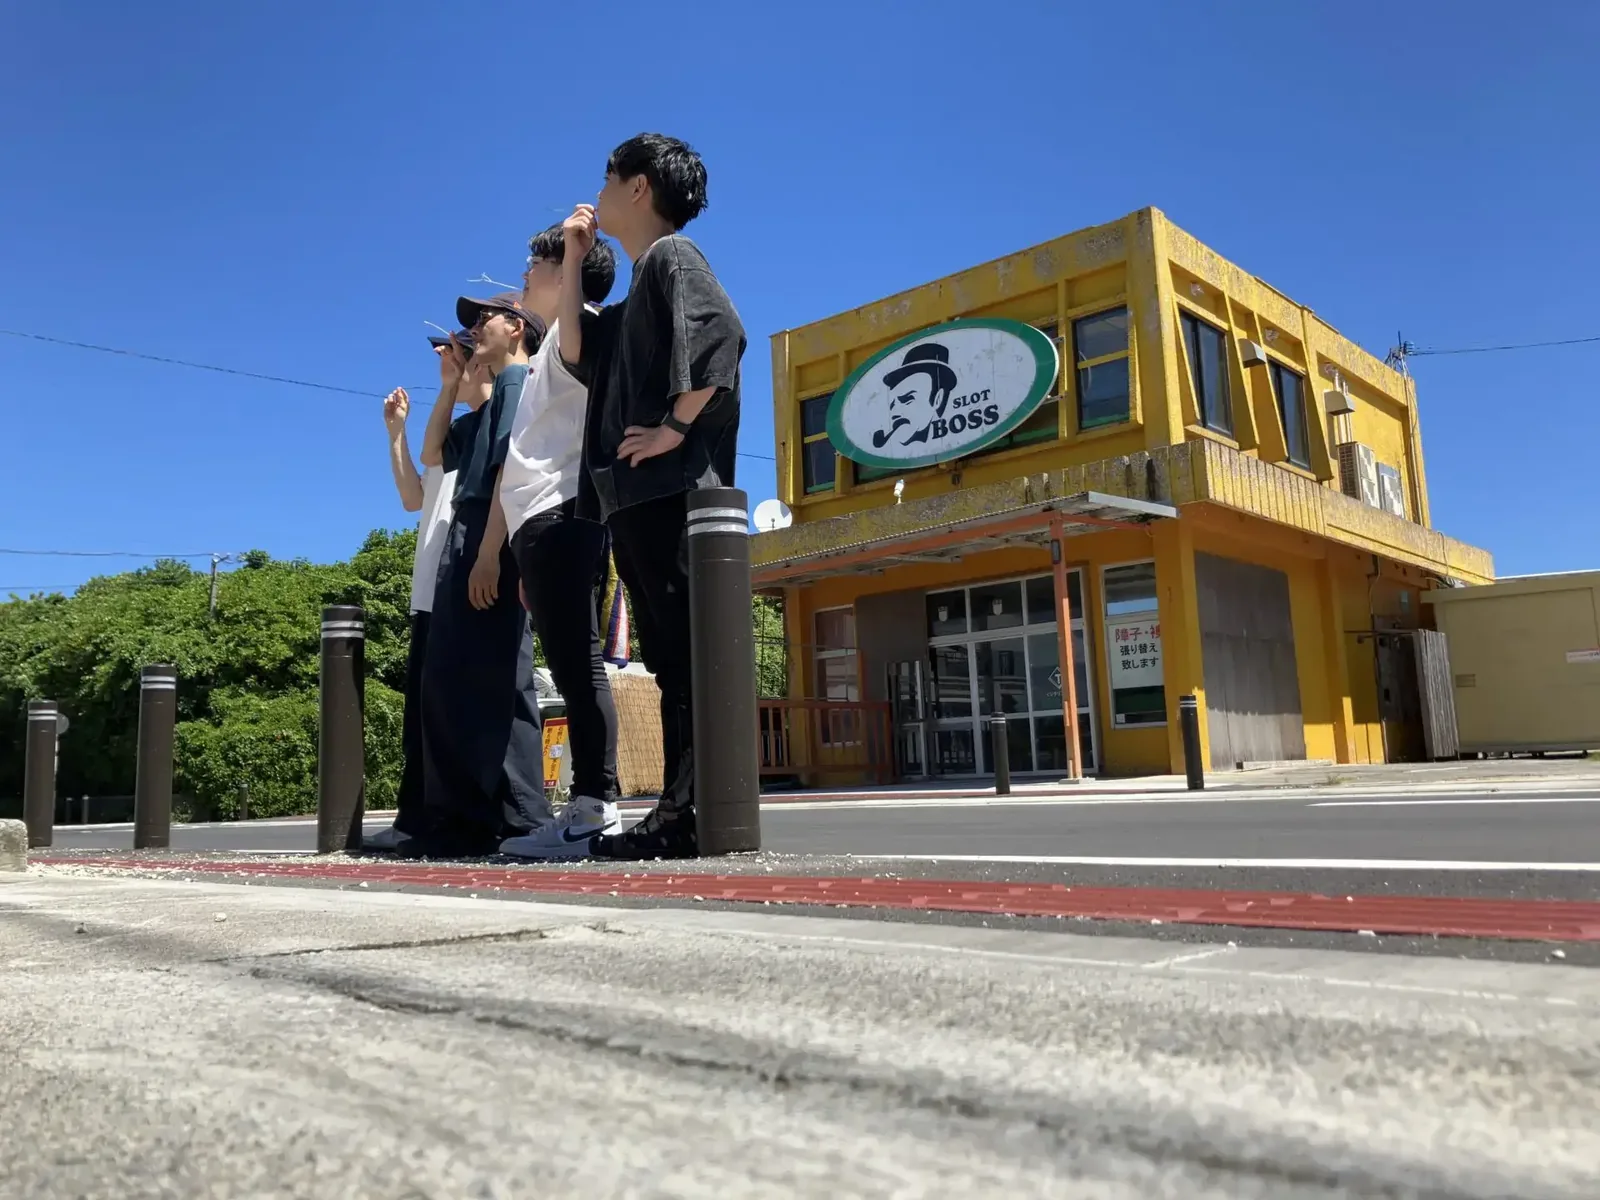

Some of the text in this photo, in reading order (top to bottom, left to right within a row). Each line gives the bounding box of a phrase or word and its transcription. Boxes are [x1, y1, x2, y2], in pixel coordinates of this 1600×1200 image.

[953, 389, 990, 409] SLOT
[931, 404, 999, 439] BOSS
[1119, 642, 1158, 656] 張り替え
[1121, 656, 1159, 670] 致します
